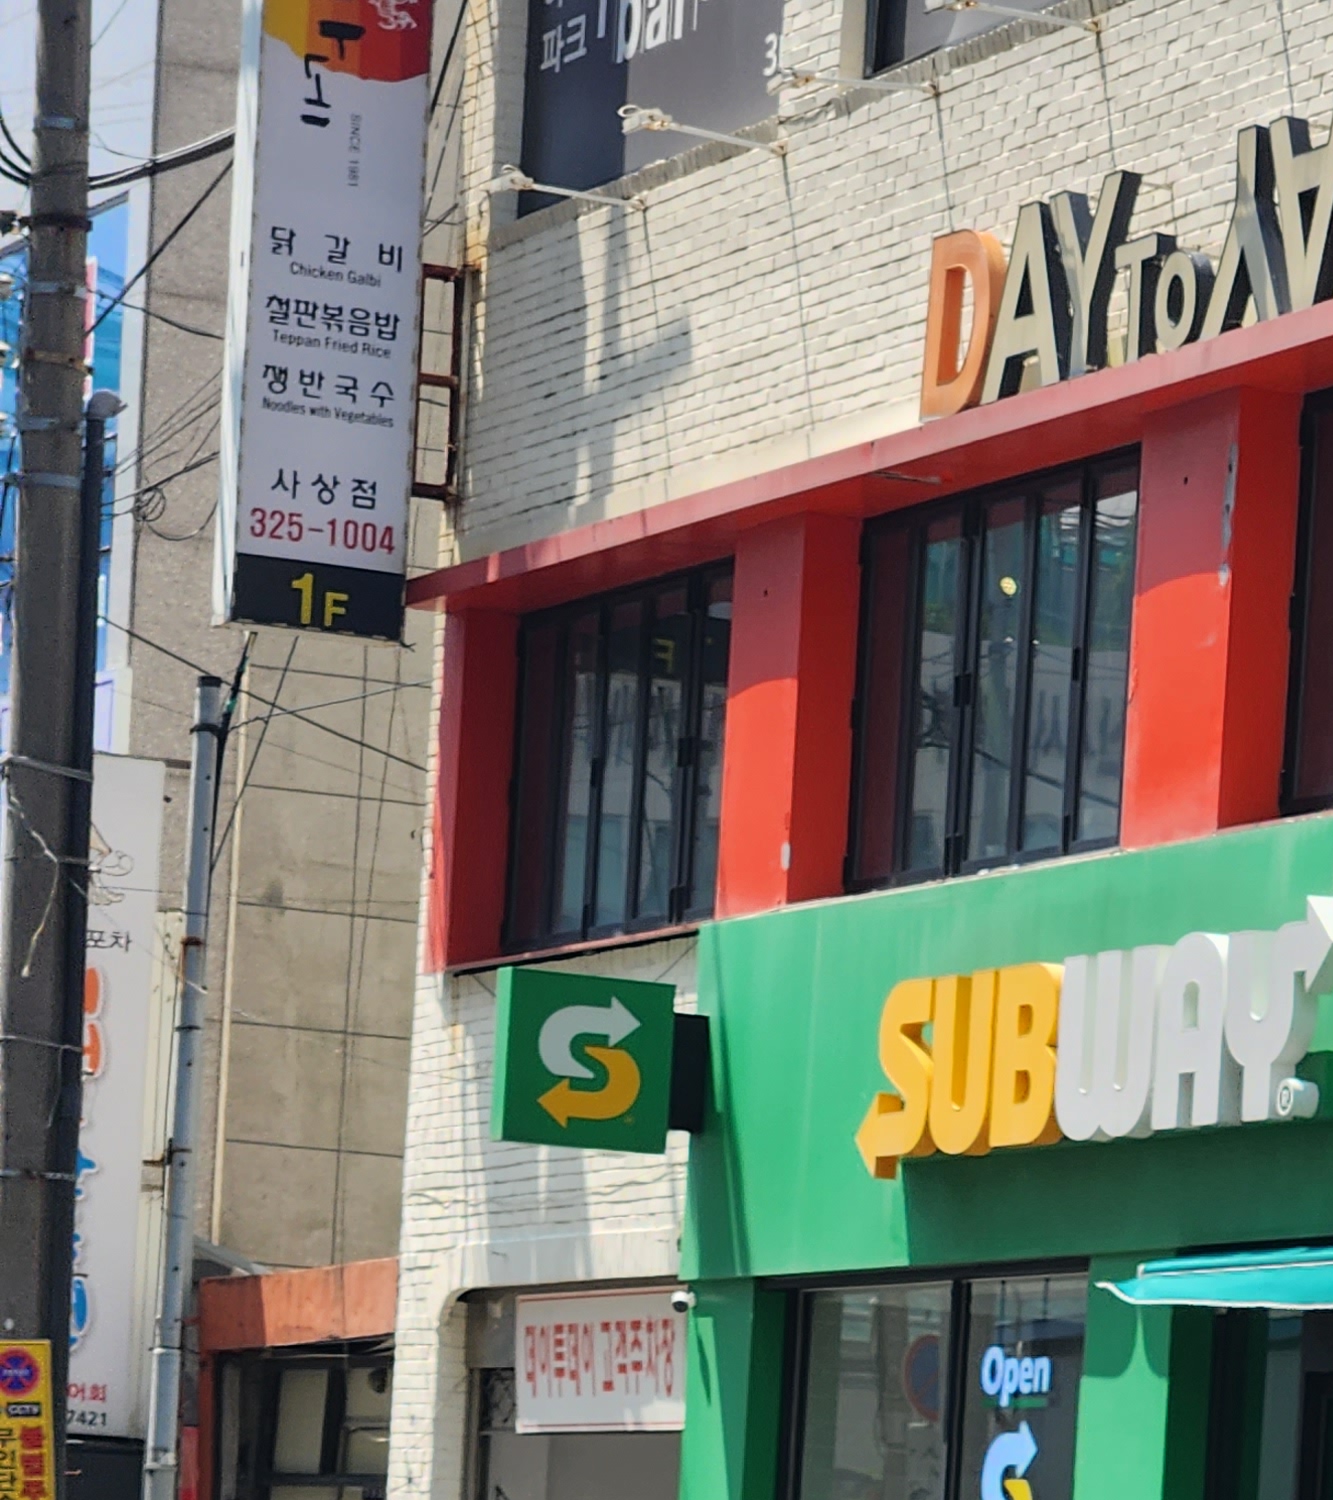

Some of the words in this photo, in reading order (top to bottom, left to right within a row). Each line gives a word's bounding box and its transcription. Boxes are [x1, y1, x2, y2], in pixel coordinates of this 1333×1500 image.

[290, 261, 343, 281] Chicken
[347, 270, 381, 288] Galbi
[266, 294, 400, 341] 철판볶음밥
[273, 329, 320, 347] Teppan
[324, 336, 358, 354] Fried
[362, 342, 391, 359] Rice
[262, 397, 305, 415] Noodles
[309, 404, 331, 418] with
[334, 407, 394, 428] Vegetables
[250, 507, 395, 555] 325-1004
[980, 1345, 1051, 1408] Open
